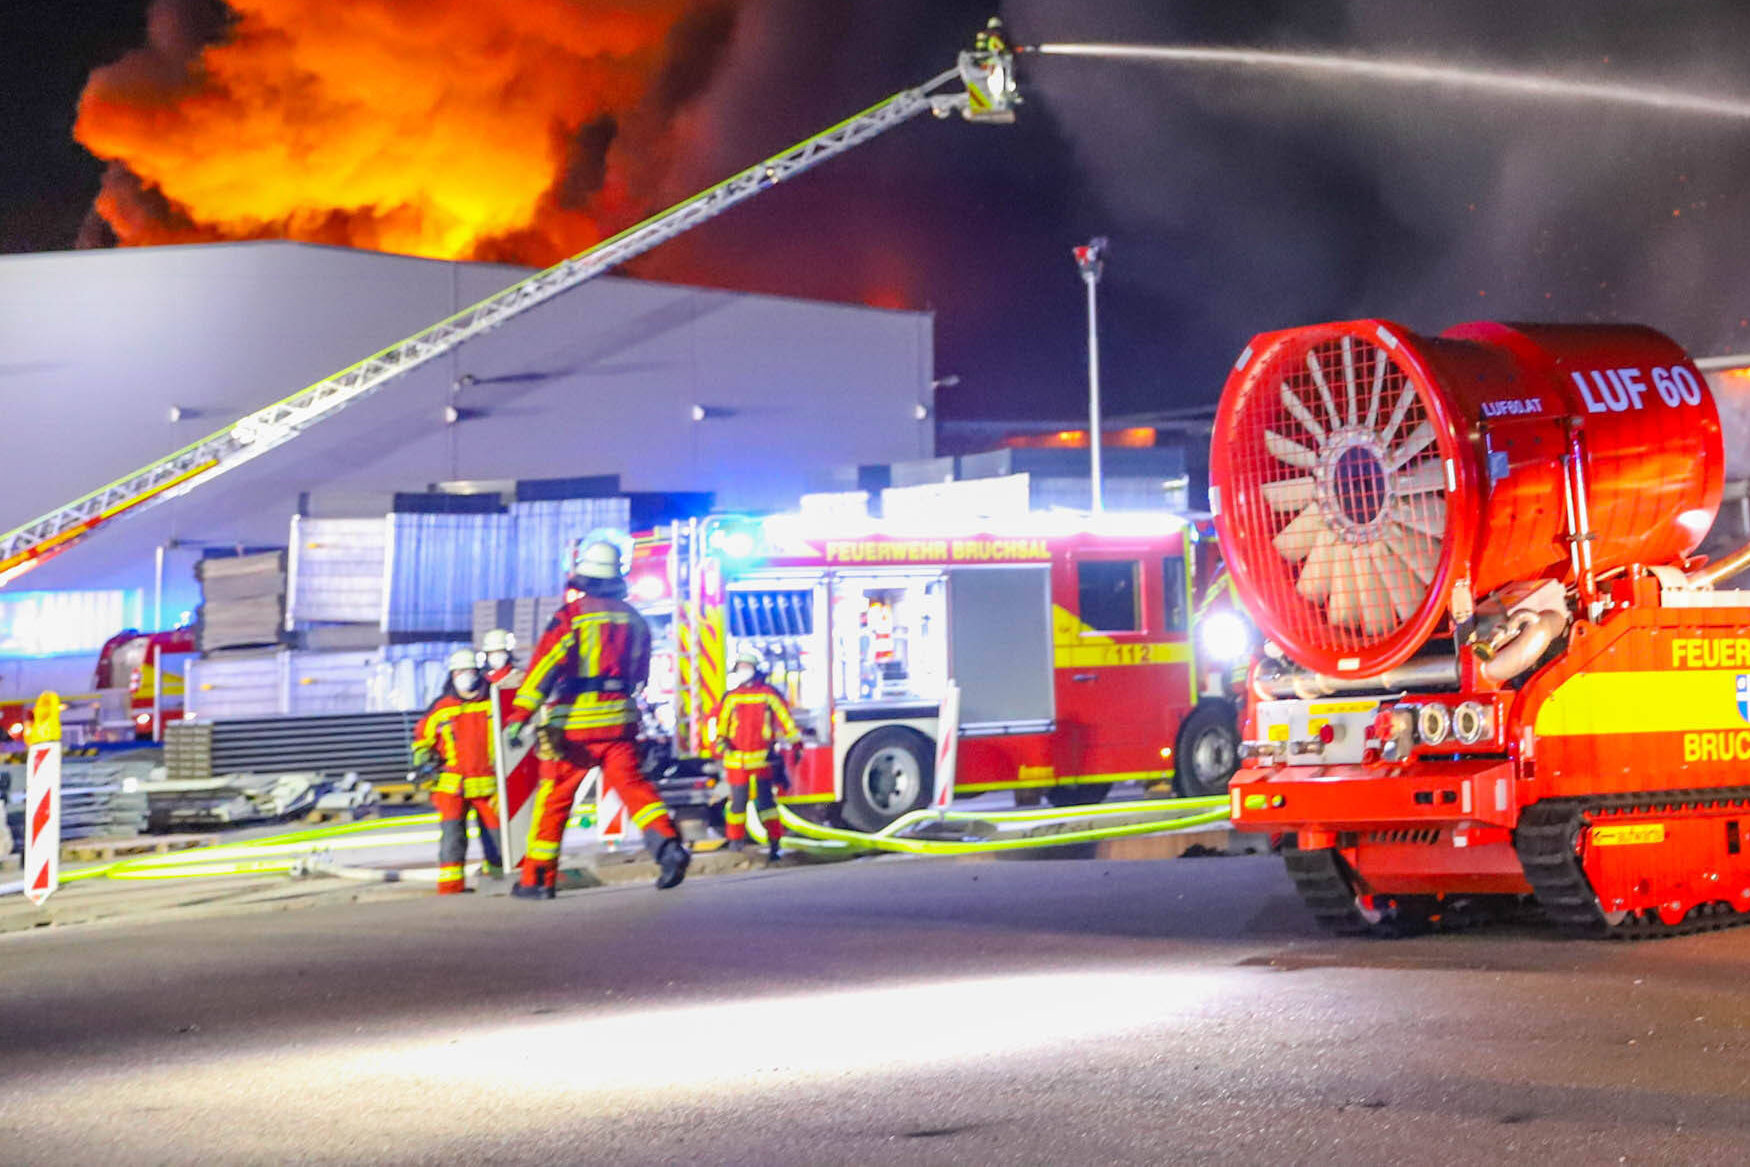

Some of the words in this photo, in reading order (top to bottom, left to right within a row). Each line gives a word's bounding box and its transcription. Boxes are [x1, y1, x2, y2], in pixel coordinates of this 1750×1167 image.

[1571, 367, 1648, 413] LUF
[1651, 365, 1702, 408] 60
[826, 540, 947, 561] FEUERWEHR
[951, 539, 1051, 560] BRUCHSAL
[1116, 645, 1151, 663] 112
